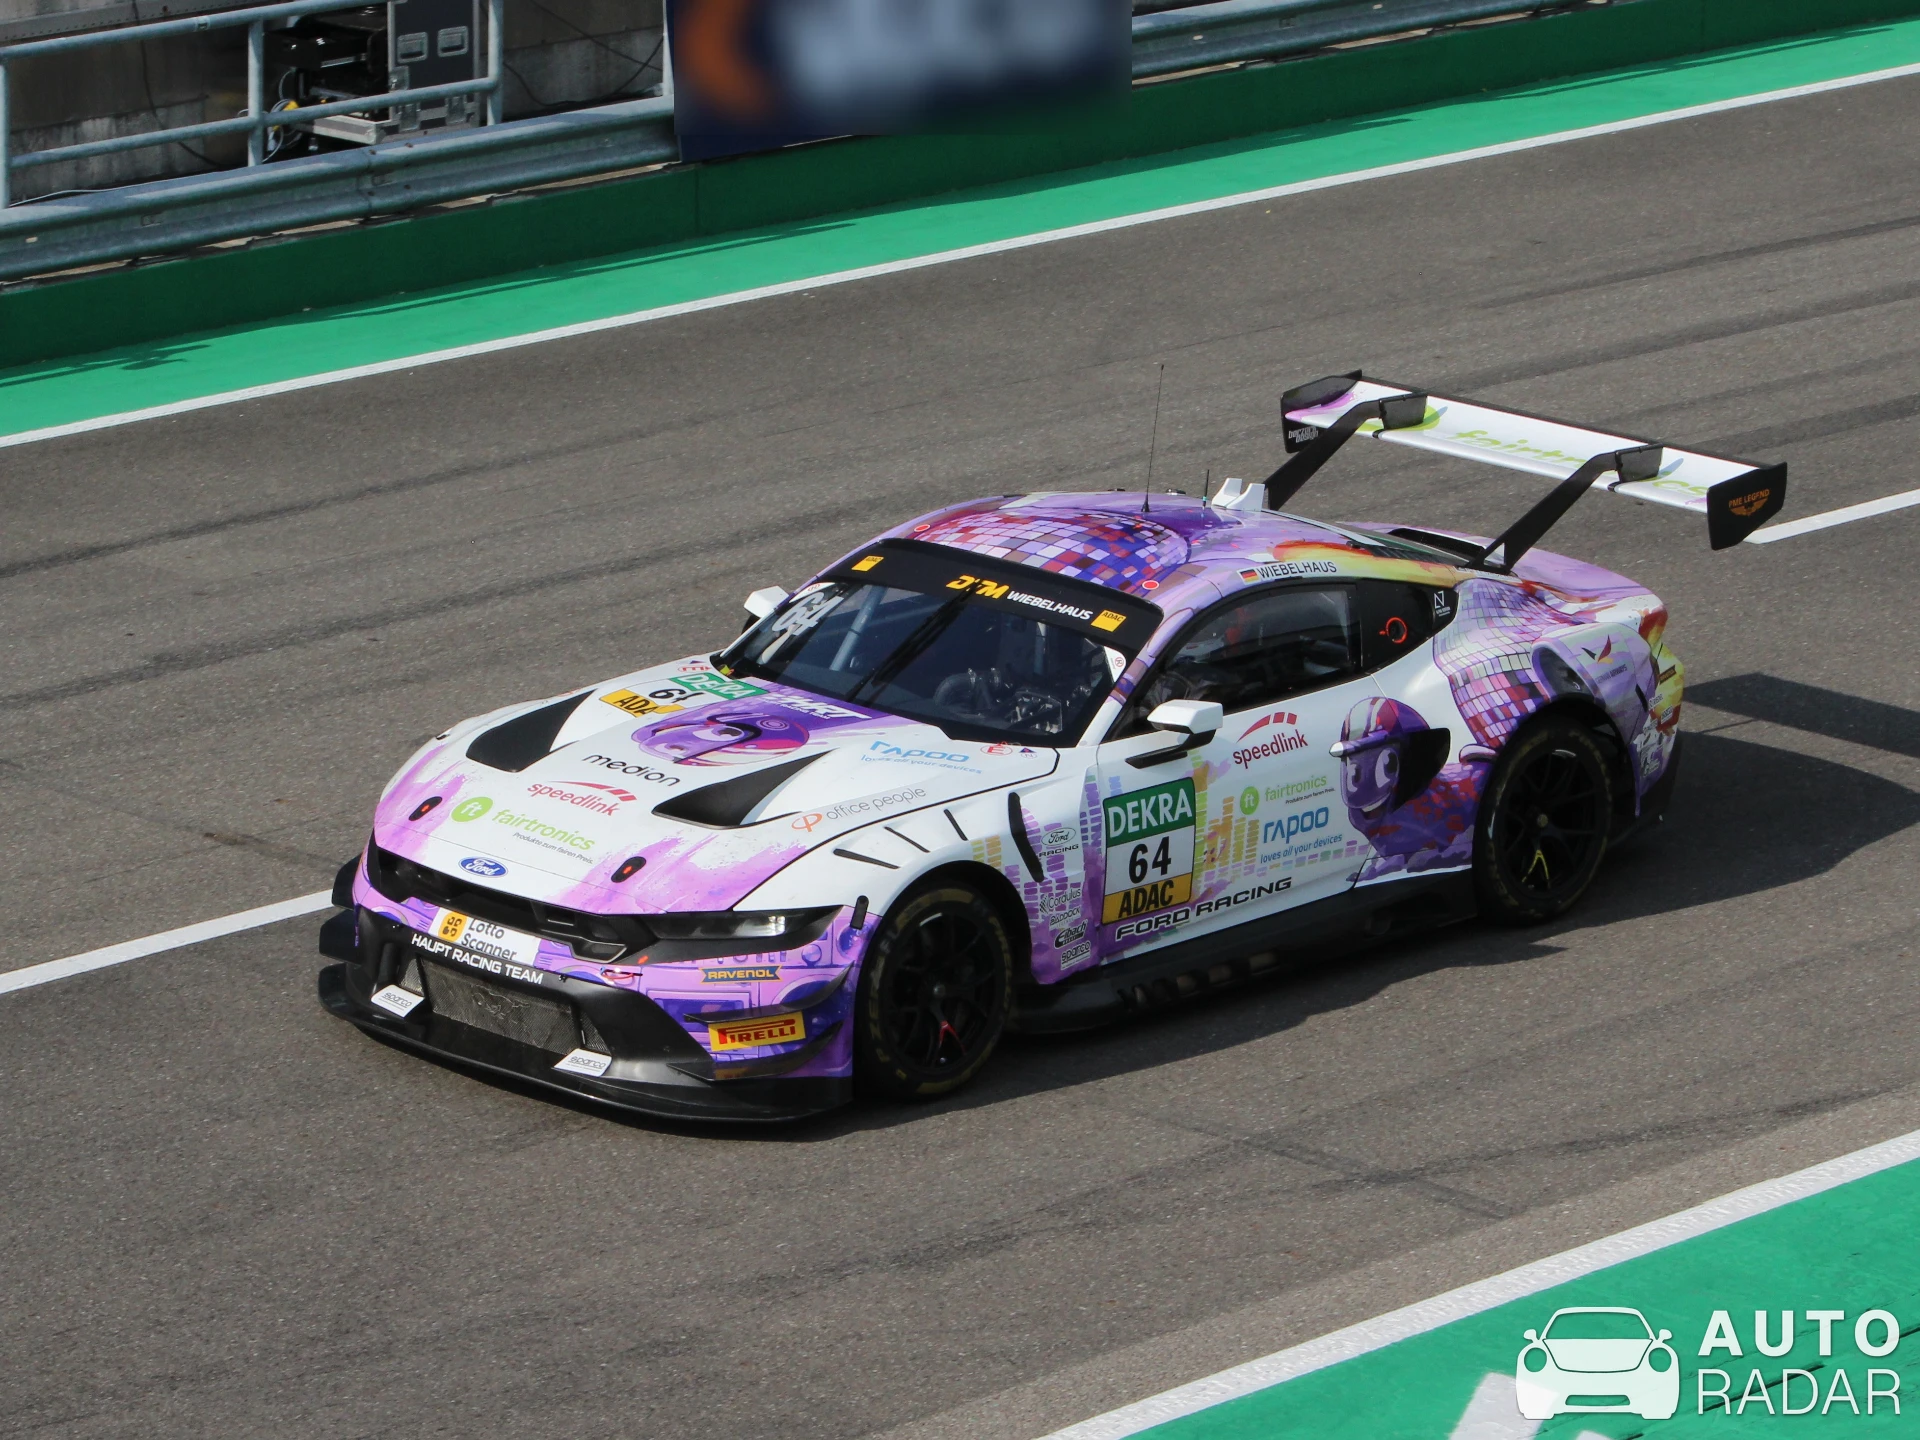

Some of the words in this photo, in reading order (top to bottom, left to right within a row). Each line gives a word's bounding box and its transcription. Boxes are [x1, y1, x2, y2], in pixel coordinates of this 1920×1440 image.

[1728, 496, 1743, 508] PME
[1744, 488, 1770, 502] LEGEND
[1256, 561, 1337, 579] WIEBELHAUS
[946, 575, 1009, 599] DM
[1006, 590, 1093, 621] WIEBELHAUS
[772, 591, 844, 636] 64
[1101, 611, 1124, 622] ADAC
[870, 741, 970, 763] rapoo
[1233, 729, 1308, 769] speedlink
[583, 753, 681, 787] medion
[910, 760, 936, 768] your
[939, 762, 982, 774] devices
[527, 782, 620, 816] speedlink
[1264, 775, 1327, 802] fairtronics
[826, 801, 870, 821] office
[872, 787, 926, 811] people
[1109, 788, 1192, 838] DEKRA
[491, 809, 595, 851] fairtronics
[1048, 831, 1069, 844] Ford
[1263, 807, 1329, 844] rapoo
[513, 832, 542, 846] Produkte
[541, 842, 557, 851] zum
[556, 847, 577, 858] fairen
[1039, 844, 1079, 858] RACING
[1260, 851, 1281, 864] loves
[1294, 843, 1316, 857] your
[1317, 834, 1342, 849] devices
[464, 858, 500, 876] Ford
[1129, 836, 1172, 884] 64
[1049, 888, 1081, 909] Cordulus
[1115, 907, 1191, 941] FORD
[1196, 877, 1293, 916] RACING
[1118, 880, 1174, 918] ADAC
[468, 918, 504, 940] Lotto
[411, 933, 452, 958] HAUPT
[452, 948, 501, 973] RACING
[505, 964, 543, 984] TEAM
[461, 936, 517, 961] Scanner
[1061, 942, 1090, 961] sparco
[708, 969, 774, 980] RAVENOL
[383, 992, 412, 1007] sparco
[717, 1018, 796, 1045] PIRELLI
[571, 1056, 606, 1068] sparco
